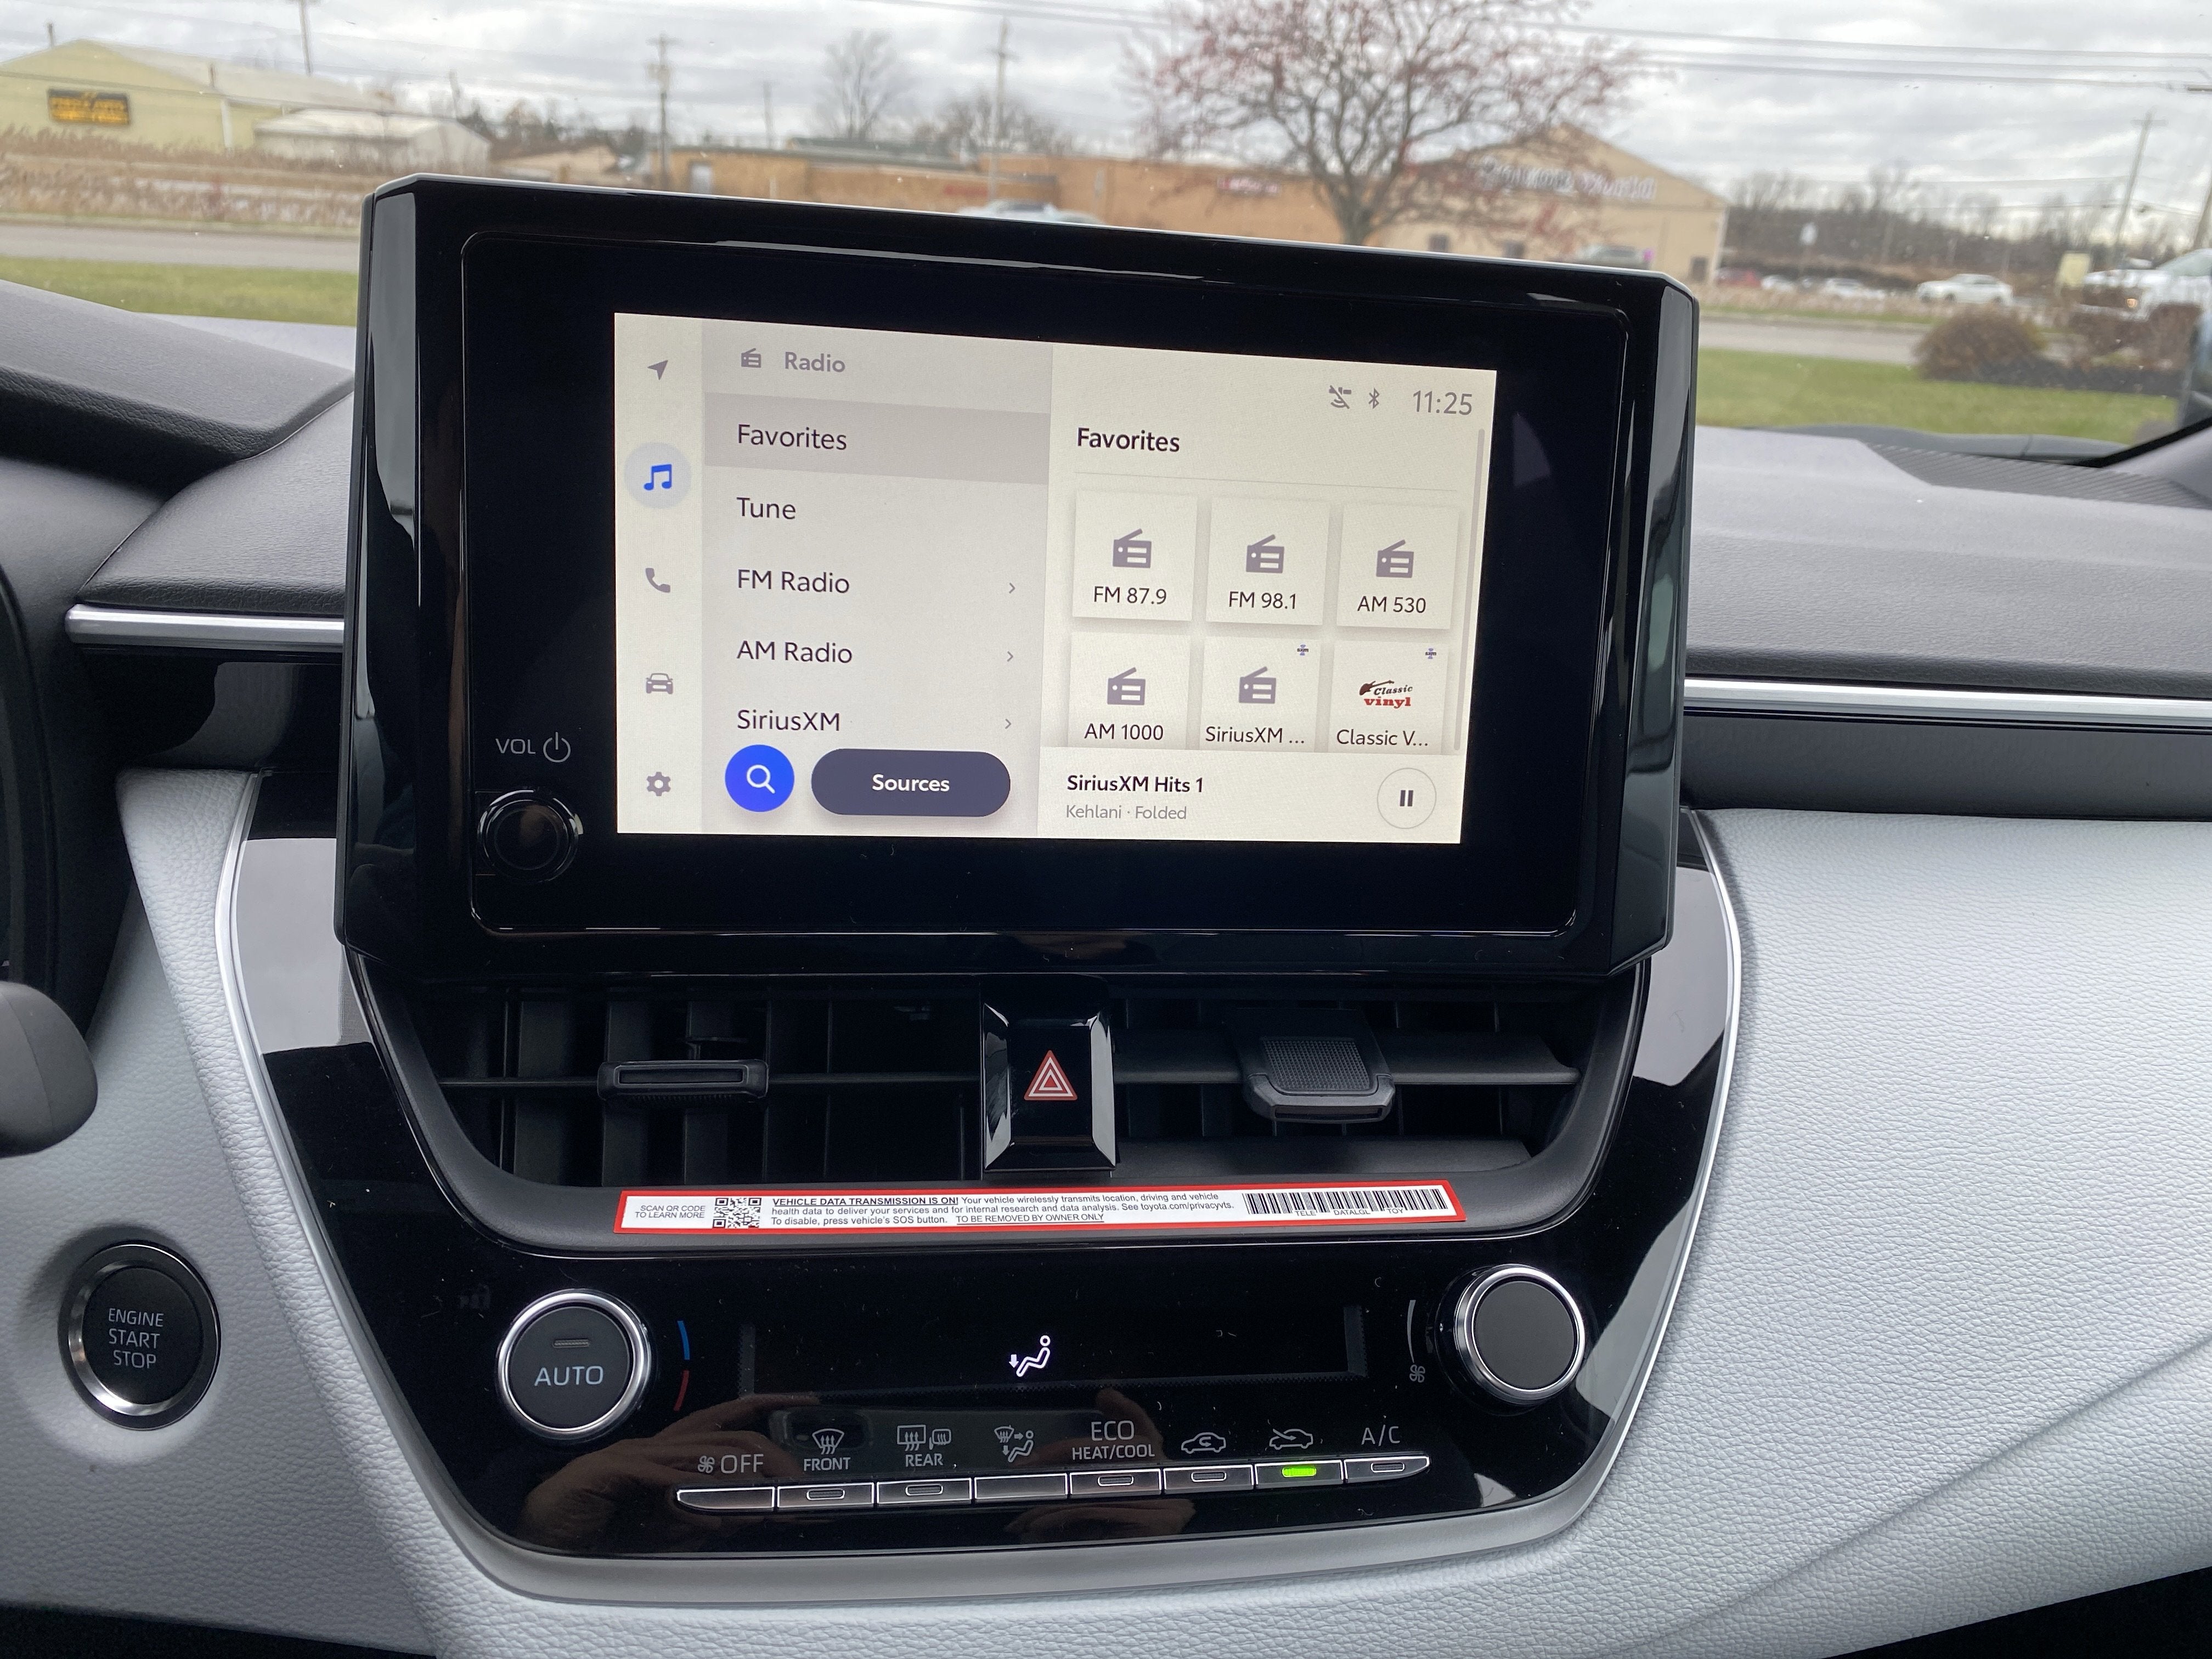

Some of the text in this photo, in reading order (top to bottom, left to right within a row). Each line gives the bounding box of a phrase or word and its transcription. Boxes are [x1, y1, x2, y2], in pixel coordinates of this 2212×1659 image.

[785, 351, 846, 374] Radio
[1413, 390, 1473, 416] 11:25
[737, 424, 848, 451] Favorites
[1076, 427, 1180, 453] Favorites
[736, 496, 797, 521] Tune
[737, 569, 850, 594] FM Radio
[1093, 585, 1167, 605] FM 87.9
[1228, 591, 1297, 610] FM 98.1
[1357, 596, 1426, 613] AM 530
[736, 640, 853, 664] AM Radio
[1373, 685, 1413, 696] Classic
[1364, 696, 1411, 709] vinyl
[736, 709, 840, 732] SiriusXM
[1084, 724, 1164, 741] AM 1000
[1205, 726, 1283, 744] SiriusXM
[1336, 729, 1429, 747] Classic V...
[495, 738, 536, 754] VOL
[872, 774, 950, 793] Sources
[1066, 775, 1203, 793] SiriusXM Hits 1
[1065, 804, 1187, 820] Kehlani Folded
[850, 1197, 926, 1205] TRANSMISSION
[1017, 1195, 1059, 1204] wirelessly
[1141, 1194, 1169, 1202] driving
[870, 1208, 890, 1216] your
[1082, 1204, 1119, 1212] analysis.
[1141, 1201, 1234, 1212] toyota.com/privacyvts.
[771, 1217, 782, 1225] To
[785, 1217, 820, 1226] disable,
[823, 1217, 848, 1226] press
[851, 1216, 890, 1224] vehicle's
[108, 1308, 164, 1327] ENGINE
[109, 1328, 160, 1349] START
[113, 1350, 157, 1369] STOP
[534, 1365, 603, 1387] AUTO
[1091, 1420, 1135, 1441] ECO
[1361, 1425, 1401, 1447] A/C
[905, 1453, 944, 1468] REAR
[1071, 1444, 1155, 1460] HEAT/COOL
[720, 1454, 764, 1474] OFF
[803, 1457, 851, 1472] FRONT
